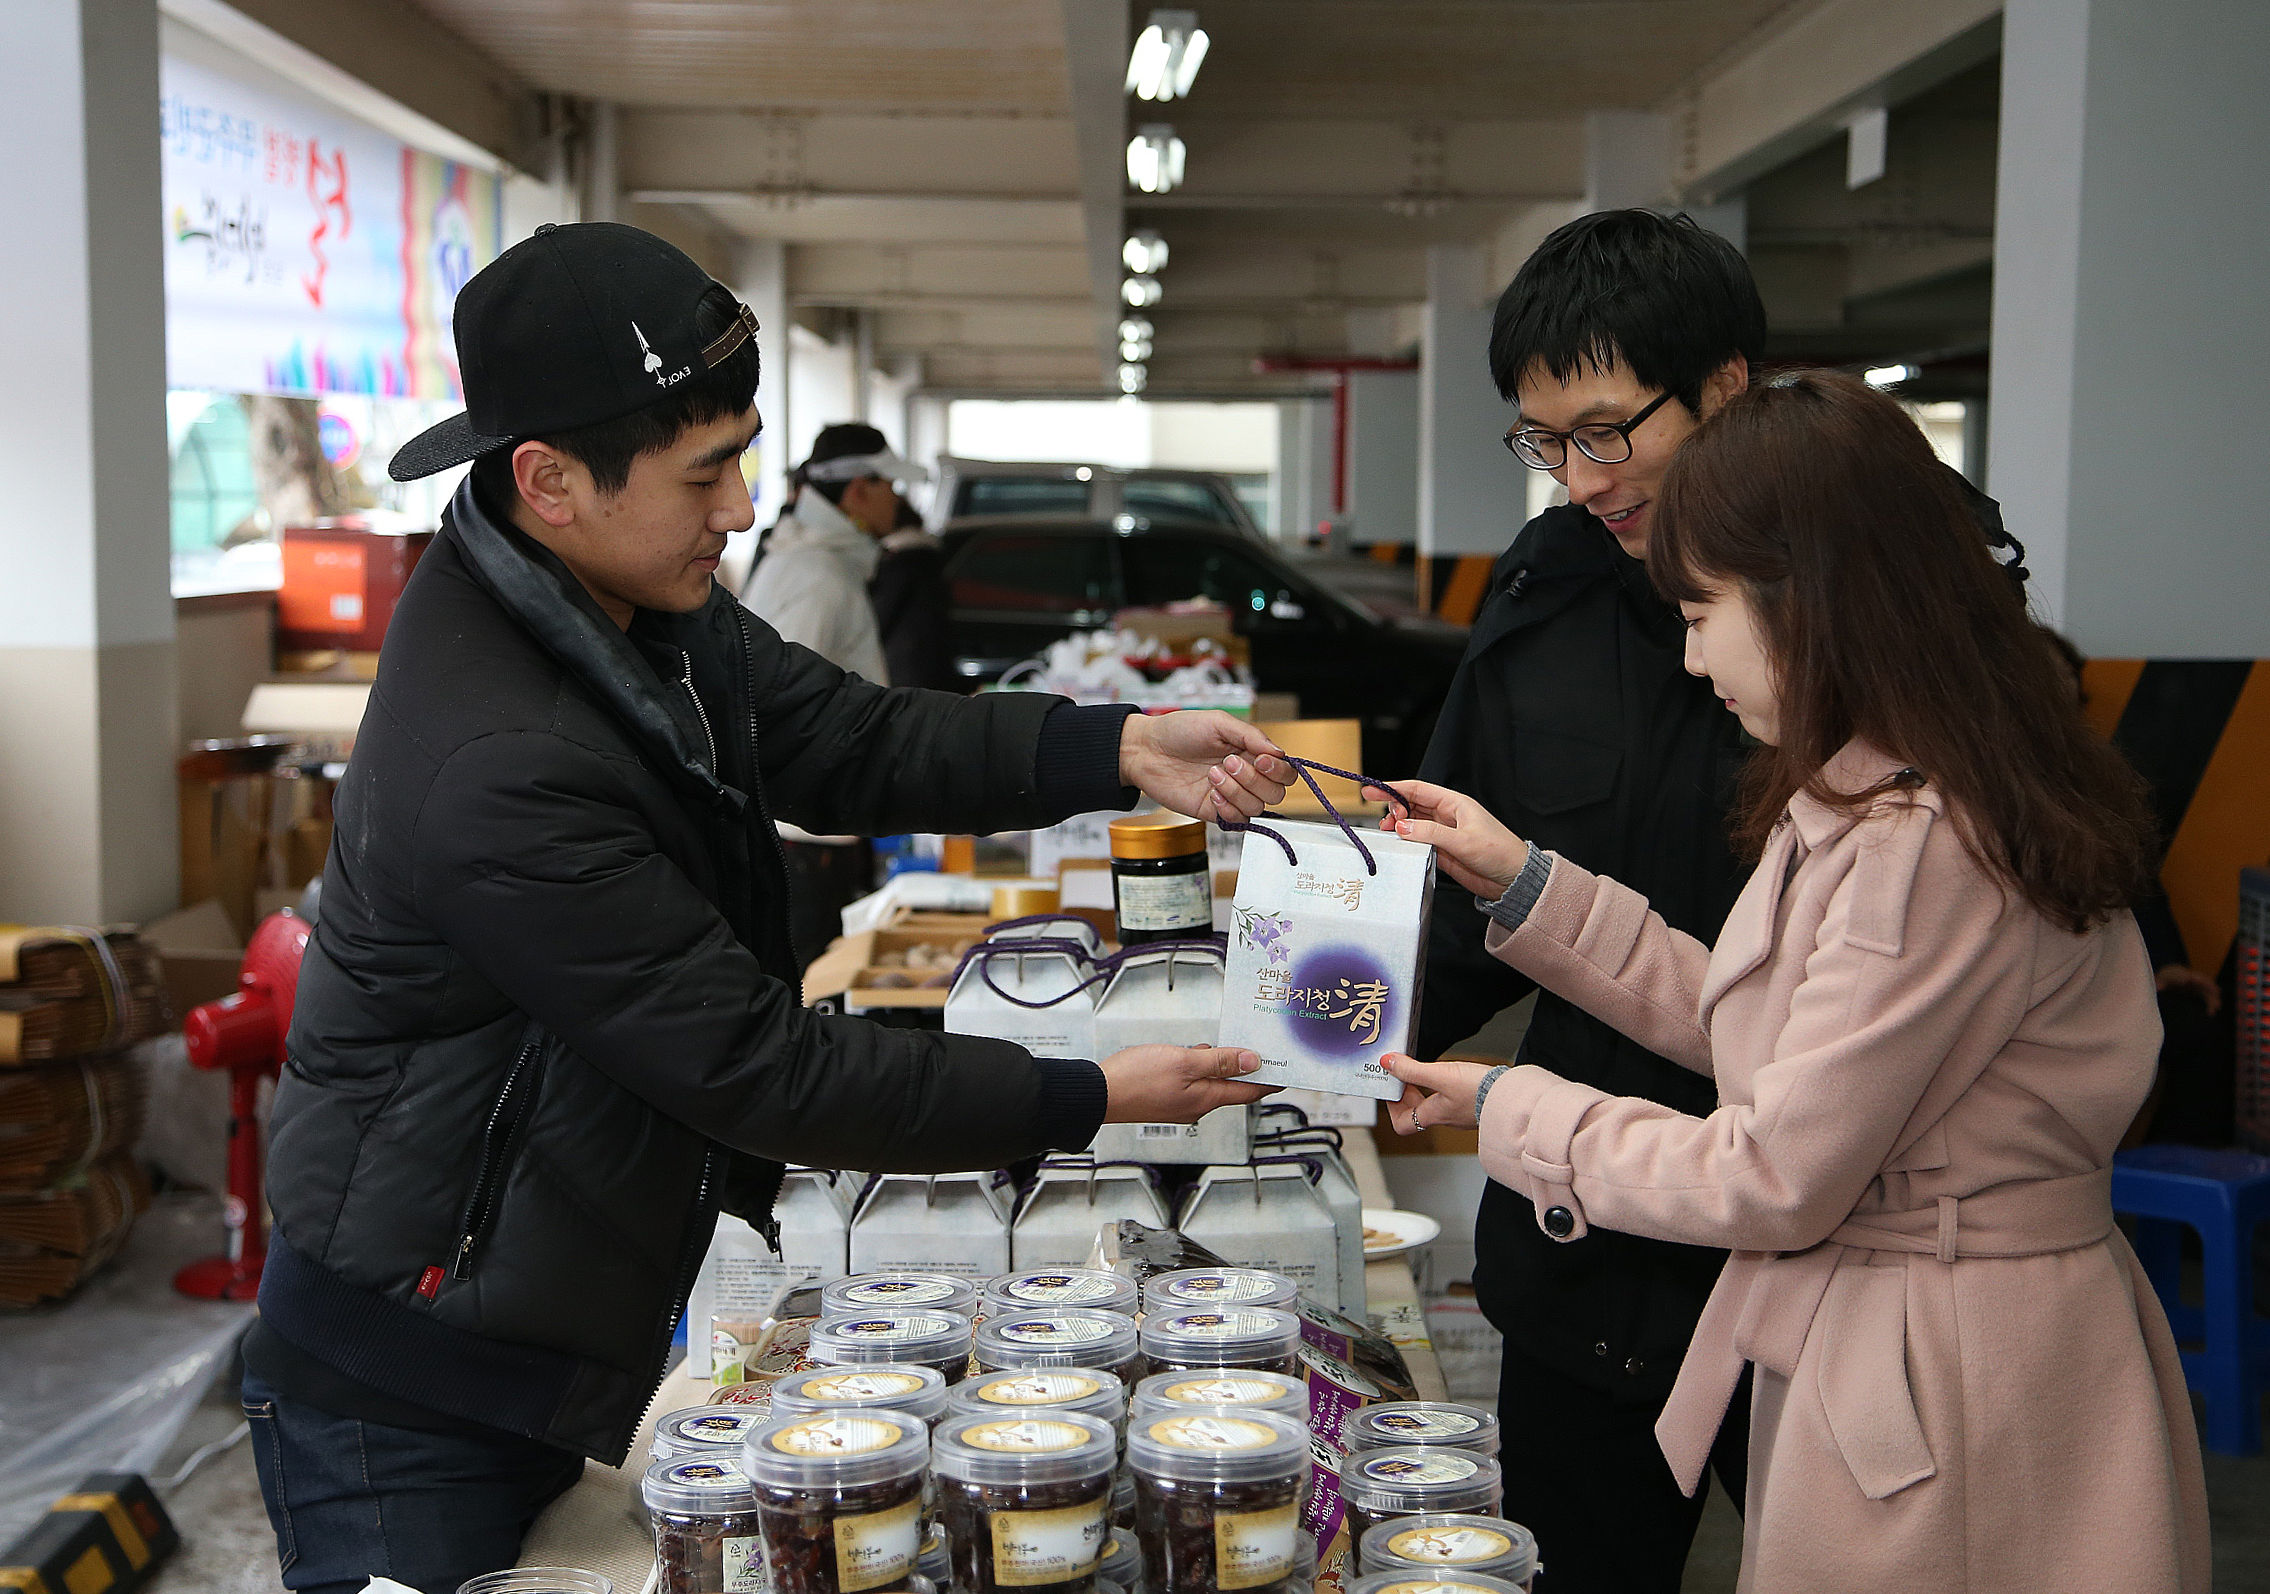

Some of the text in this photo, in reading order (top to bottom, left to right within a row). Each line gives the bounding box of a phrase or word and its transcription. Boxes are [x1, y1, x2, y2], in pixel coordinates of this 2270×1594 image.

[1296, 872, 1315, 880] 산마을
[1294, 880, 1334, 895] 도라지청
[1256, 967, 1294, 984] 산마을
[1254, 983, 1331, 1012] 도라지청
[1298, 1009, 1328, 1021] Extract
[1261, 1058, 1288, 1067] nmaeul
[1363, 1063, 1381, 1074] 500
